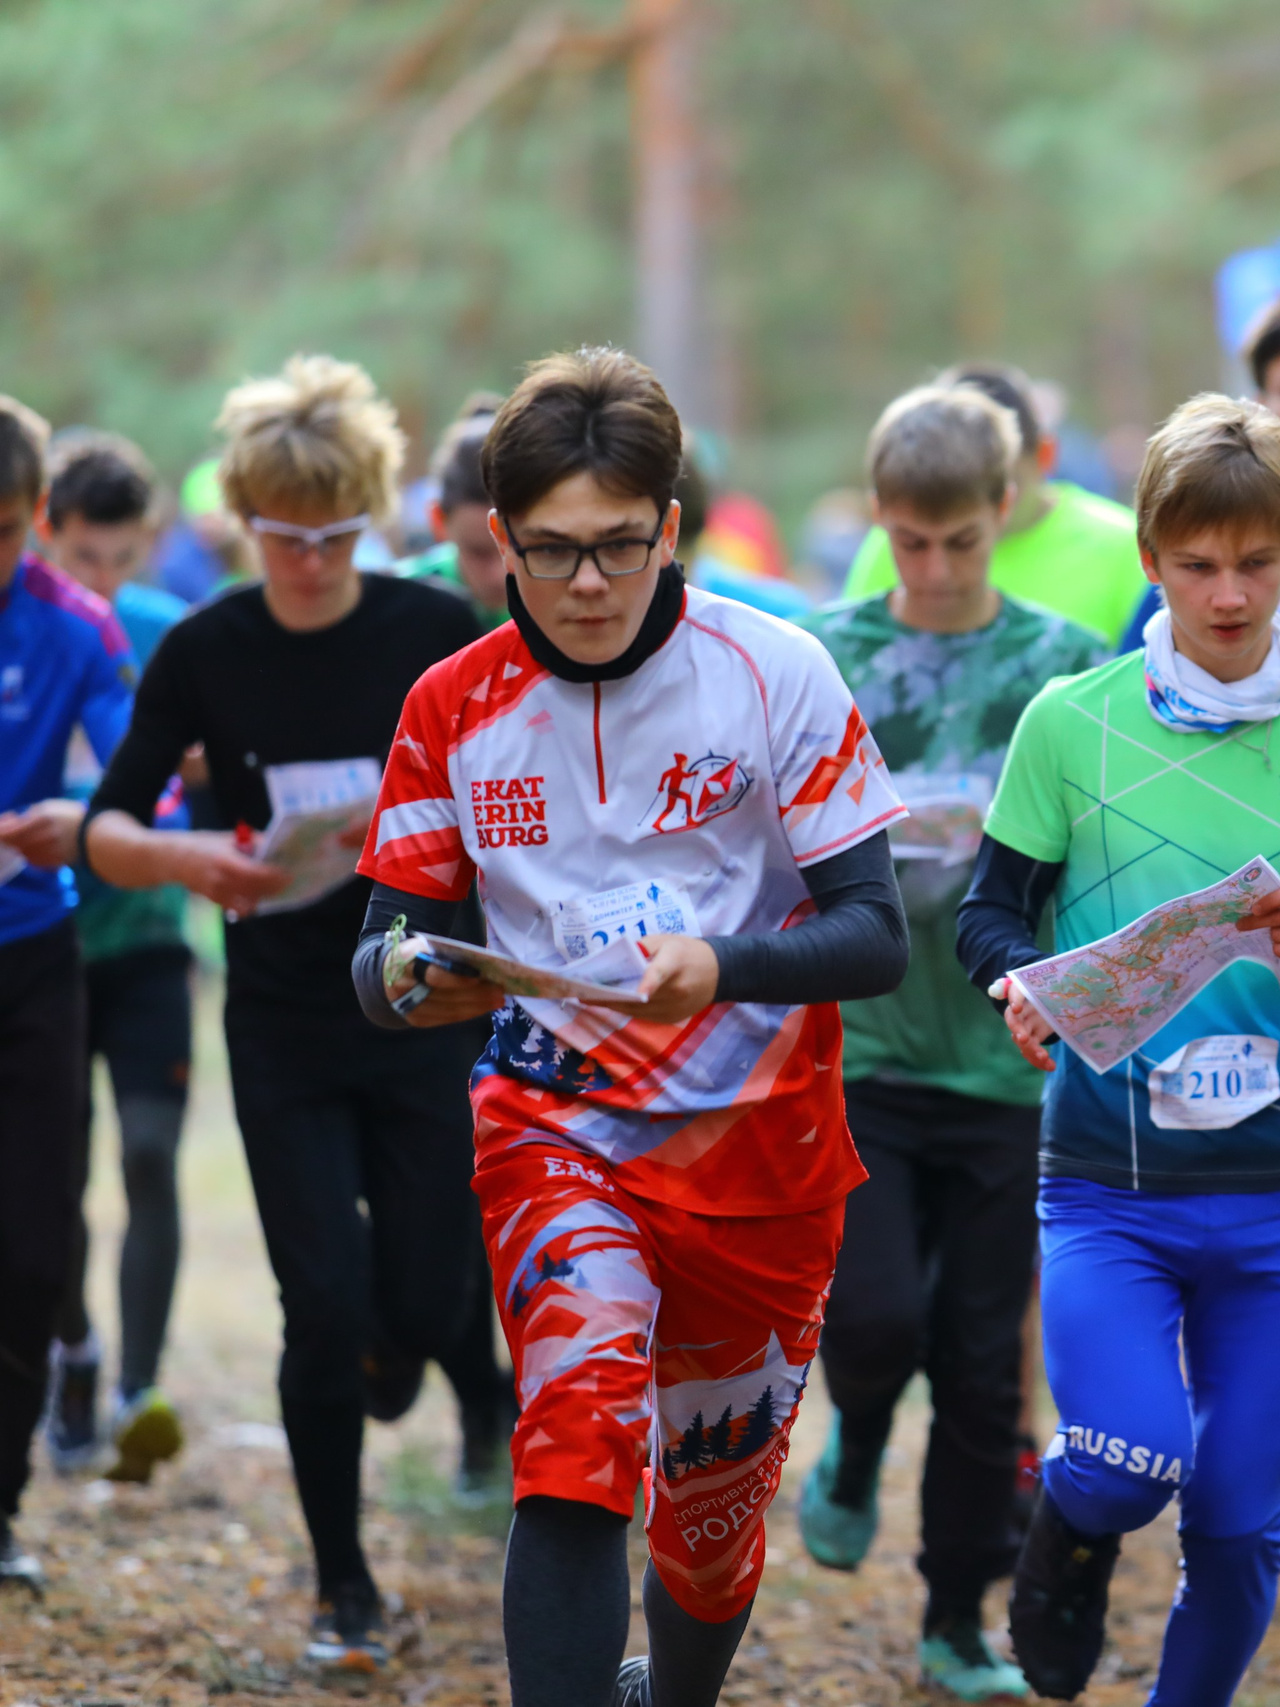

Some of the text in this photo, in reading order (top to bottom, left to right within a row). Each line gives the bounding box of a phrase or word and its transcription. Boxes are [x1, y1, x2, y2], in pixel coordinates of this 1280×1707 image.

[471, 776, 544, 802] EKAT
[473, 800, 546, 826] ERIN
[477, 824, 549, 849] BURG
[1188, 1069, 1242, 1099] 210
[1069, 1425, 1182, 1483] RUSSIA
[674, 1466, 765, 1525] СПОРТИВНАЯ
